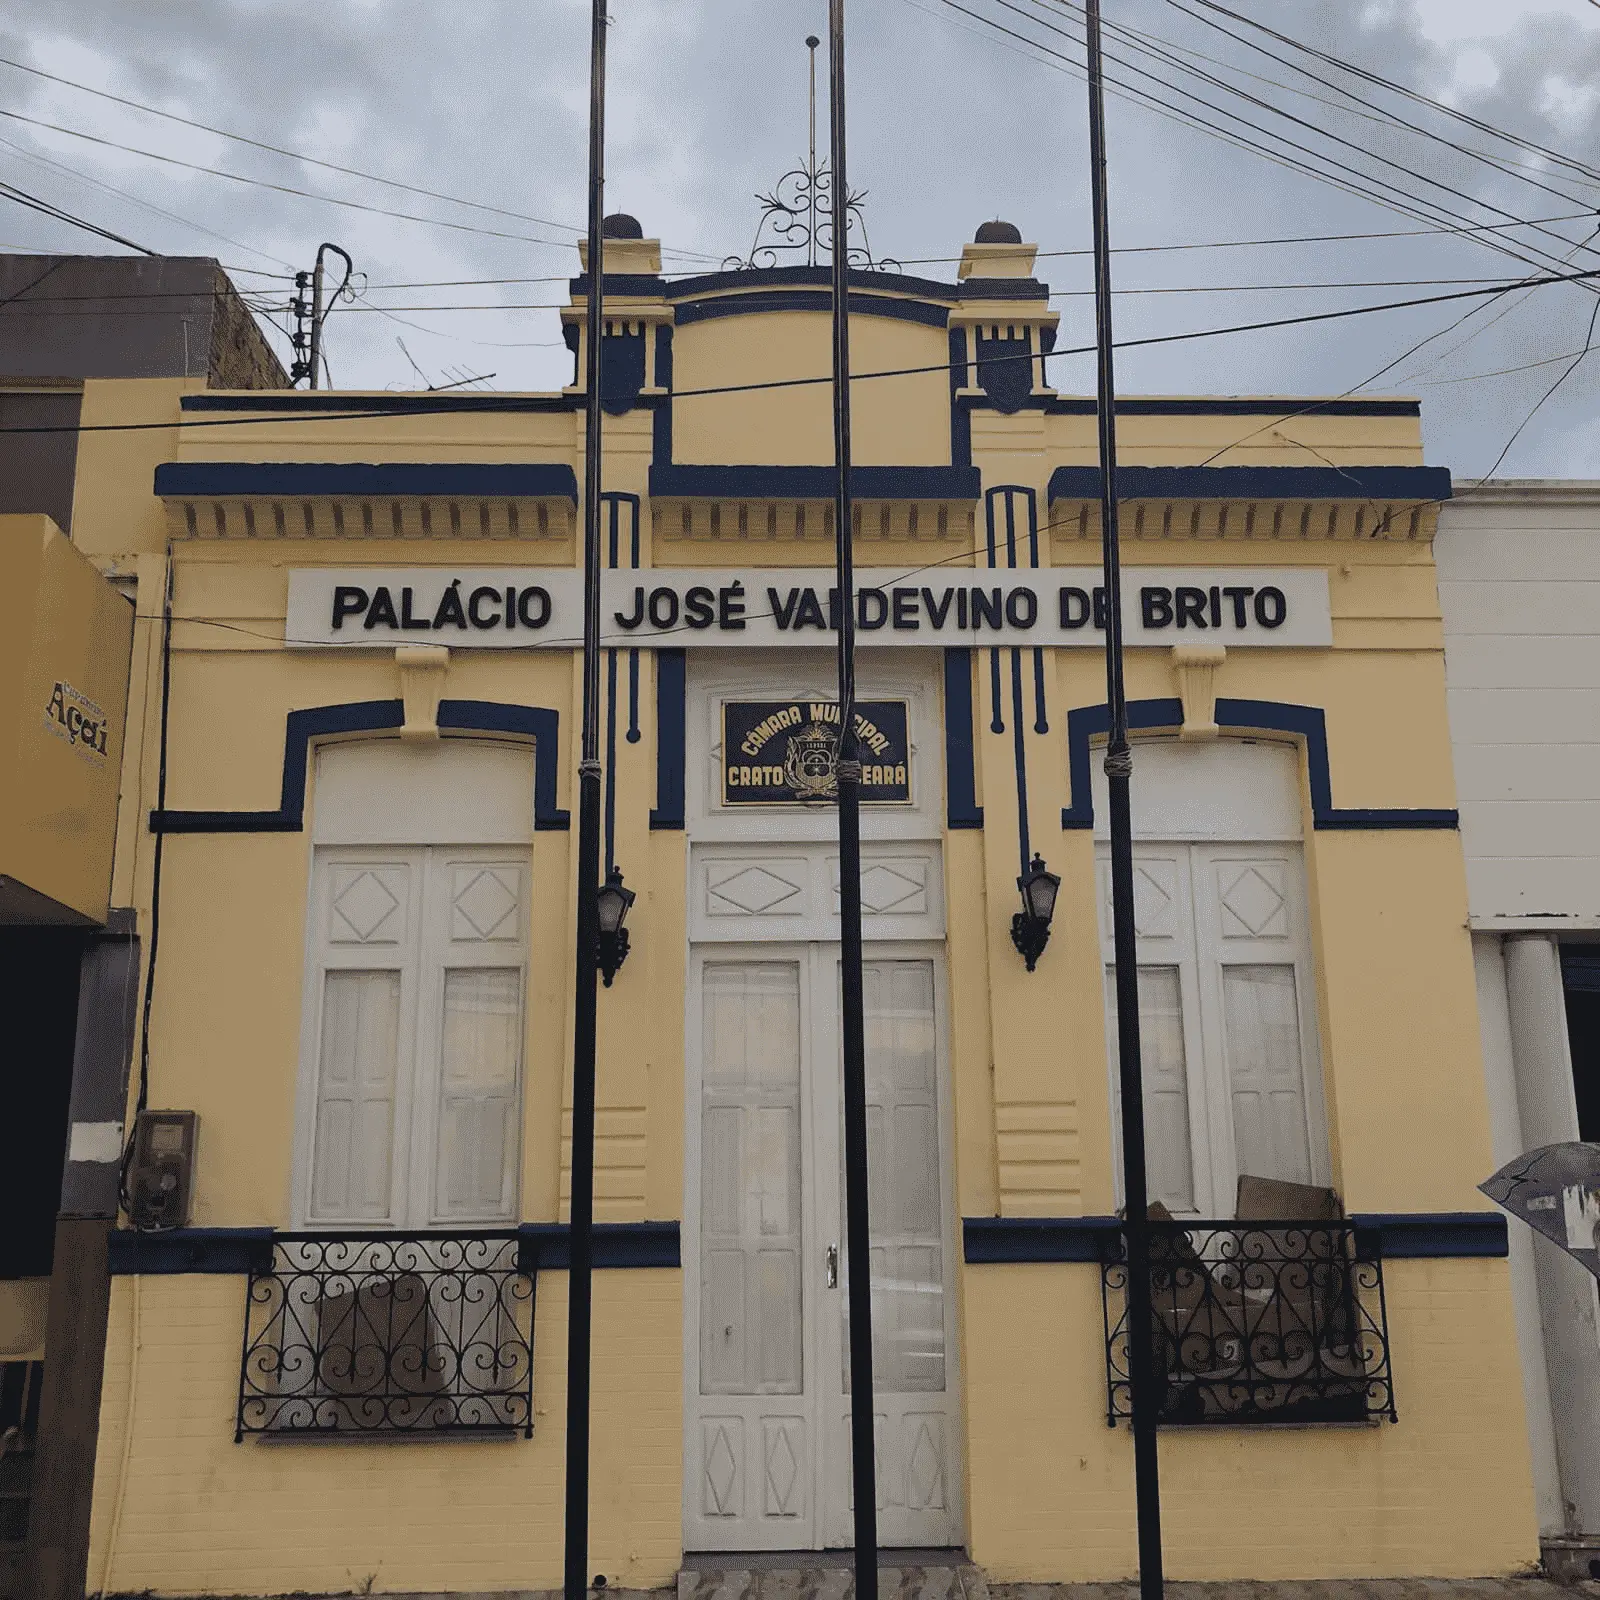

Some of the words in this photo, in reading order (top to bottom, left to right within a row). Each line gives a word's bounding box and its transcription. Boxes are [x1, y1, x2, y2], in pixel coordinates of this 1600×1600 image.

[332, 578, 552, 630] PALÁCIO
[614, 580, 745, 630] JOSÉ
[1141, 586, 1287, 630] BRITO
[741, 705, 802, 756] CÂMARA
[728, 766, 784, 786] CRATO
[859, 761, 906, 785] EARÁ
